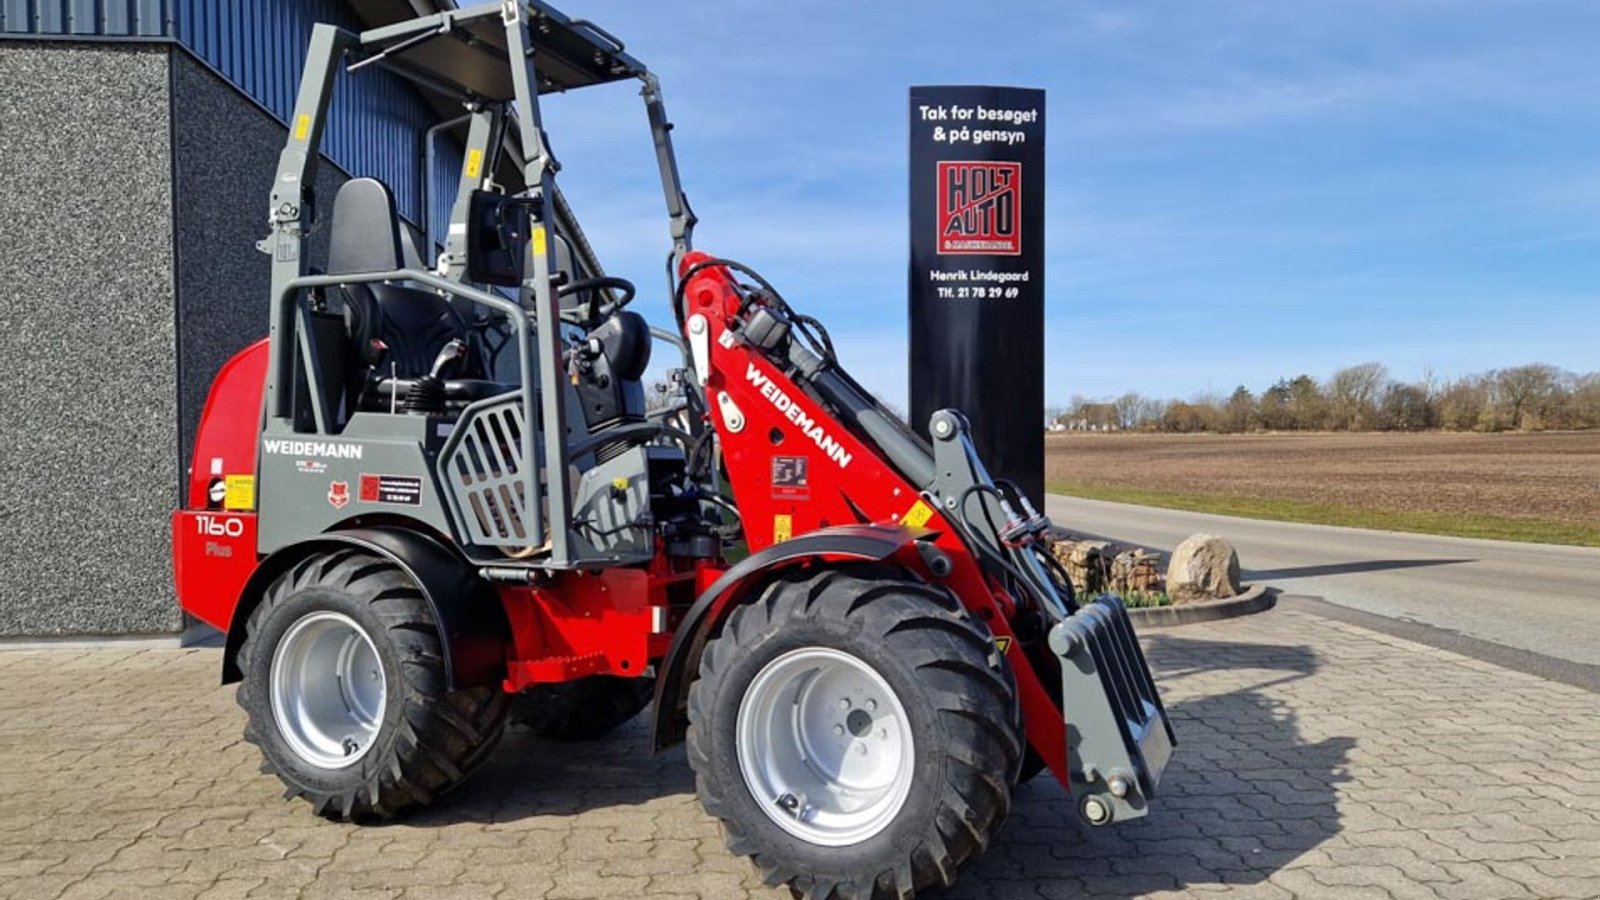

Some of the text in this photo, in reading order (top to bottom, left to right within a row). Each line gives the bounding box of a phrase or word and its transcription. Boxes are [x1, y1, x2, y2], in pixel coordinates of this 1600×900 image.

[919, 105, 1038, 124] Tak for besøget
[933, 126, 1026, 145] & på gensyn
[946, 166, 1014, 216] HOLT
[943, 187, 1015, 237] AUTO
[929, 269, 1029, 284] Henrik Lindegaard
[937, 286, 1019, 299] Tlf. 21 78 29 69
[745, 362, 853, 469] WEIDEMANN
[263, 439, 363, 460] WEIDEMANN
[195, 514, 244, 538] 1160
[205, 541, 233, 558] Plus
